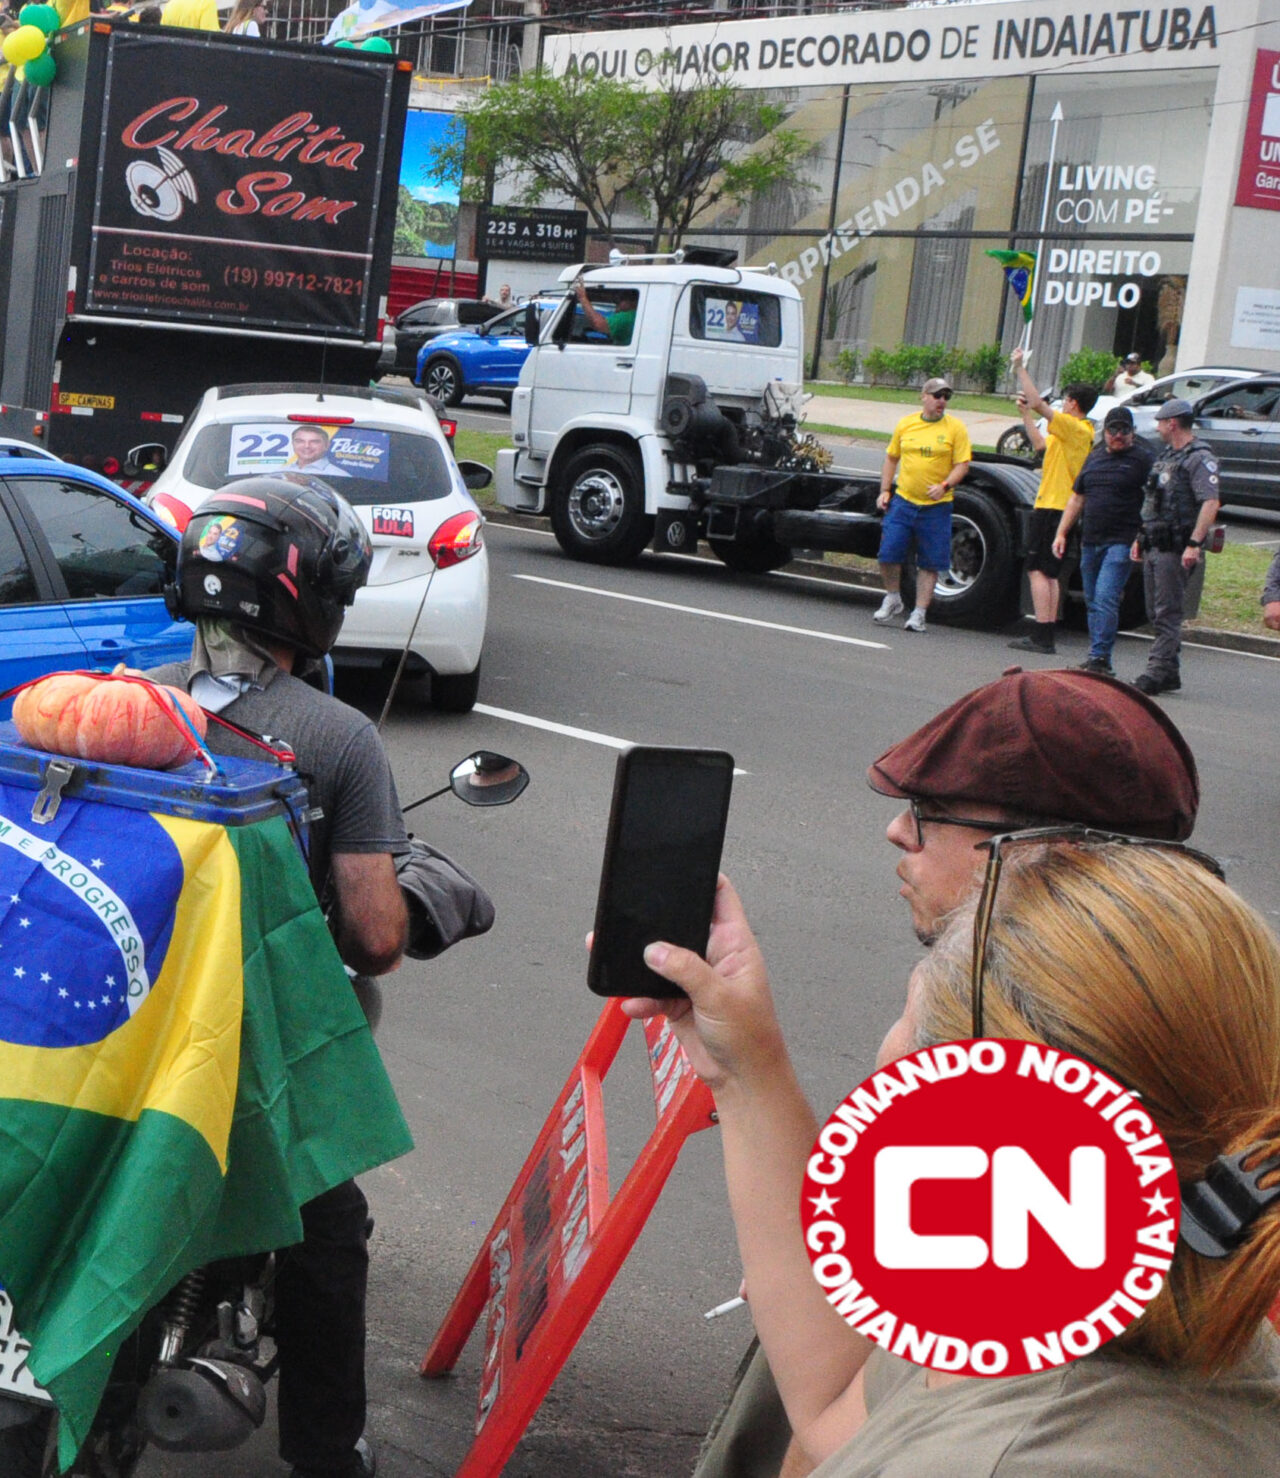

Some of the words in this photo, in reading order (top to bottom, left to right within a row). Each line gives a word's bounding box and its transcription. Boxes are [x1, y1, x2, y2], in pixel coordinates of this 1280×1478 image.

[565, 49, 627, 79] AQUI
[635, 48, 653, 77] O
[662, 41, 750, 76] MAIOR
[758, 29, 931, 70] DECORADO
[940, 25, 980, 59] DE
[992, 5, 1218, 60] INDAIATUBA
[121, 96, 365, 171] Chalita
[1059, 165, 1157, 190] LIVING
[216, 171, 358, 224] Som
[775, 118, 1001, 287] RPREENDA-SE
[1056, 198, 1119, 223] COM
[1124, 191, 1175, 224] PÉ-
[487, 220, 517, 235] 225
[522, 226, 531, 236] A
[536, 223, 562, 238] 318
[122, 242, 193, 261] Locação:
[1048, 249, 1162, 277] DIREITO
[110, 260, 143, 273] Trios
[99, 273, 108, 283] e
[111, 274, 156, 288] carros
[160, 277, 177, 289] de
[181, 282, 211, 293] som
[223, 265, 259, 289] (19)
[264, 270, 364, 296] 99712-7821
[1044, 281, 1141, 308] DUPLO
[707, 308, 725, 327] 22
[236, 434, 290, 459] 22
[372, 508, 413, 523] FORA
[374, 519, 414, 537] LULA
[18, 837, 34, 850] E
[39, 846, 145, 999] PROGRESSO
